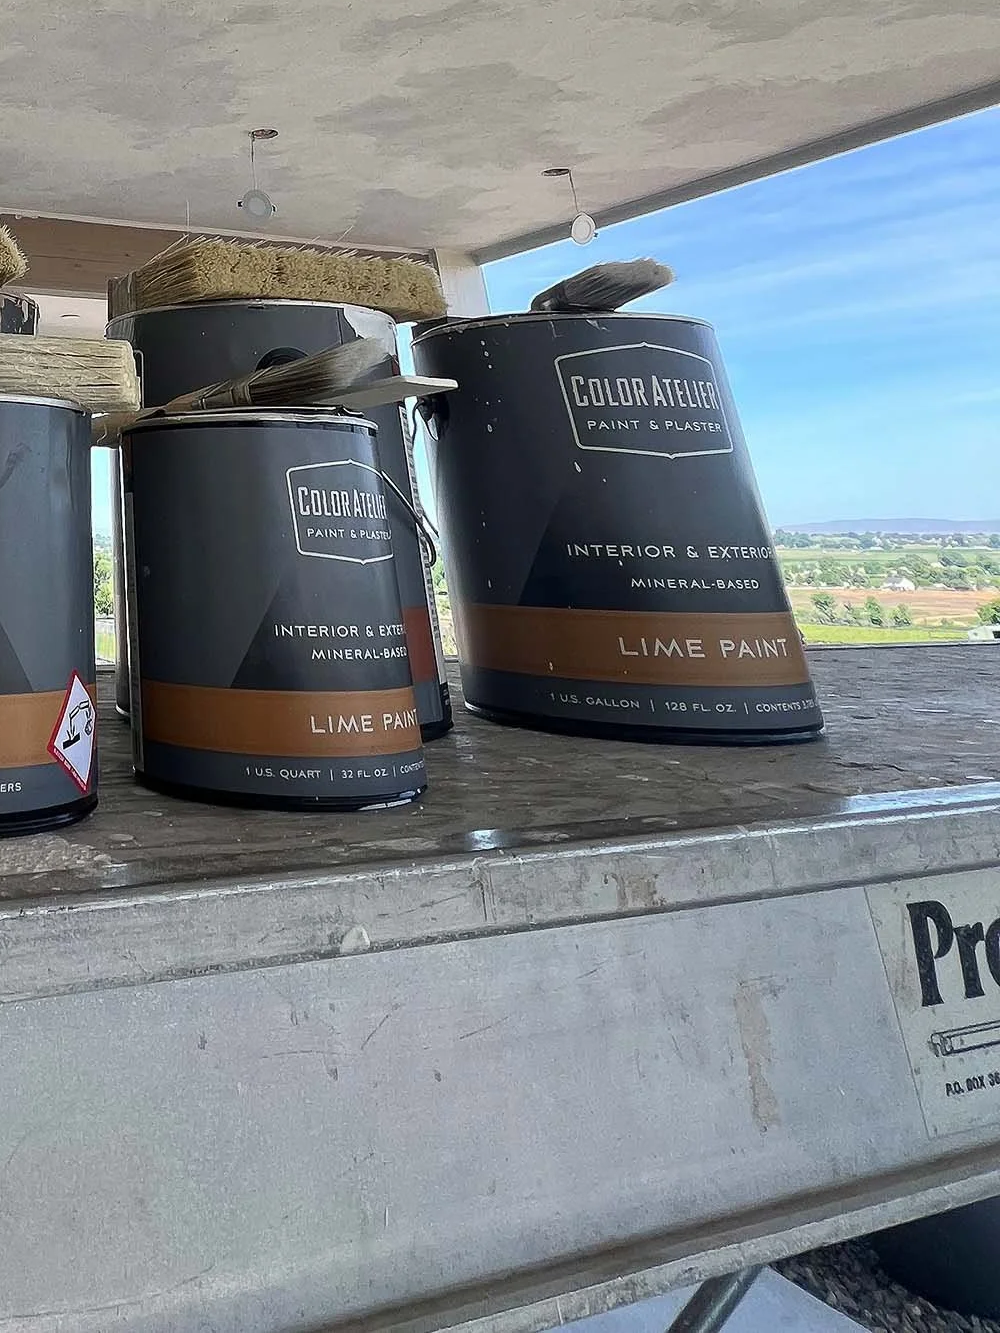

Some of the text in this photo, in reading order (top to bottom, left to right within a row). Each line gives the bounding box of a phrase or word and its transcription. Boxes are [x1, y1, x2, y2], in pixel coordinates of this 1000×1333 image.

[587, 420, 723, 433] PAINT & PLASTER
[307, 528, 345, 539] PAINT
[350, 529, 358, 539] &
[567, 544, 676, 559] INTERIOR
[686, 545, 700, 559] &
[631, 578, 760, 590] MINERAL-BASED
[274, 624, 360, 638] INTERIOR
[365, 625, 374, 637] &
[311, 646, 407, 661] MINERAL-BASED
[618, 636, 788, 659] LIME PAINT
[550, 692, 556, 702] 1
[561, 693, 582, 705] U.S.
[585, 695, 640, 709] GALLON
[664, 701, 688, 712] 128
[755, 699, 801, 714] CONTENTS
[310, 708, 418, 735] LIME PAINT
[255, 768, 276, 778] U.S.
[279, 768, 321, 780] QUART
[341, 770, 354, 780] 32
